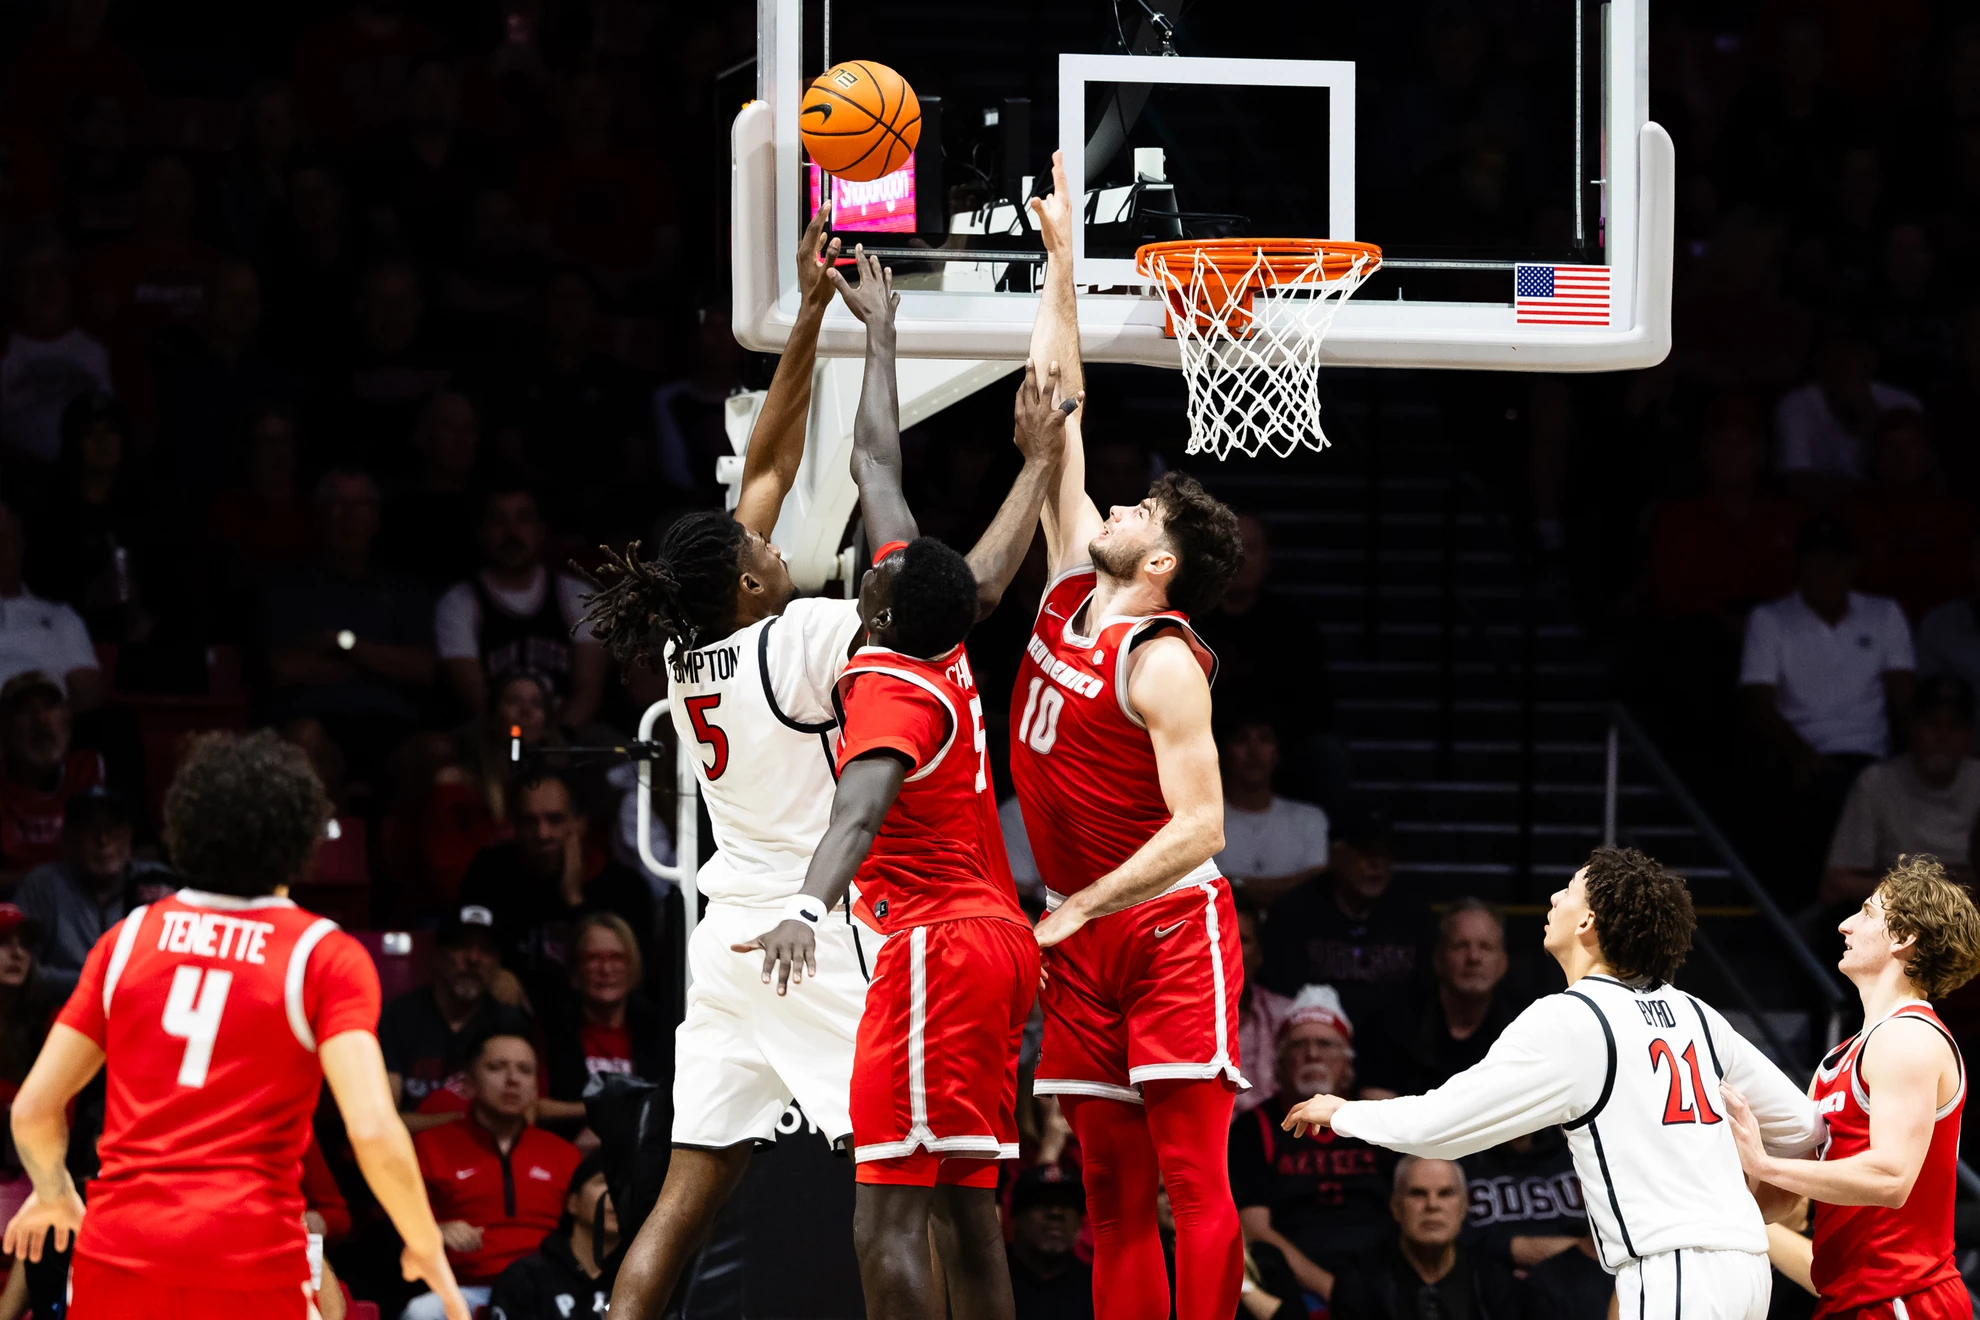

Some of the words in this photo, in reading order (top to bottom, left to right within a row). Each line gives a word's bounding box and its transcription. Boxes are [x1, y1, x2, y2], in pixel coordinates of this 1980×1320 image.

[1040, 652, 1104, 699] MEXICO
[684, 693, 729, 781] 5
[1018, 676, 1065, 755] 10
[157, 911, 275, 965] TENETTE
[161, 965, 233, 1090] 4
[1635, 999, 1677, 1034] BYRD
[1648, 1037, 1723, 1126] 21
[1468, 1169, 1588, 1228] SDSU
